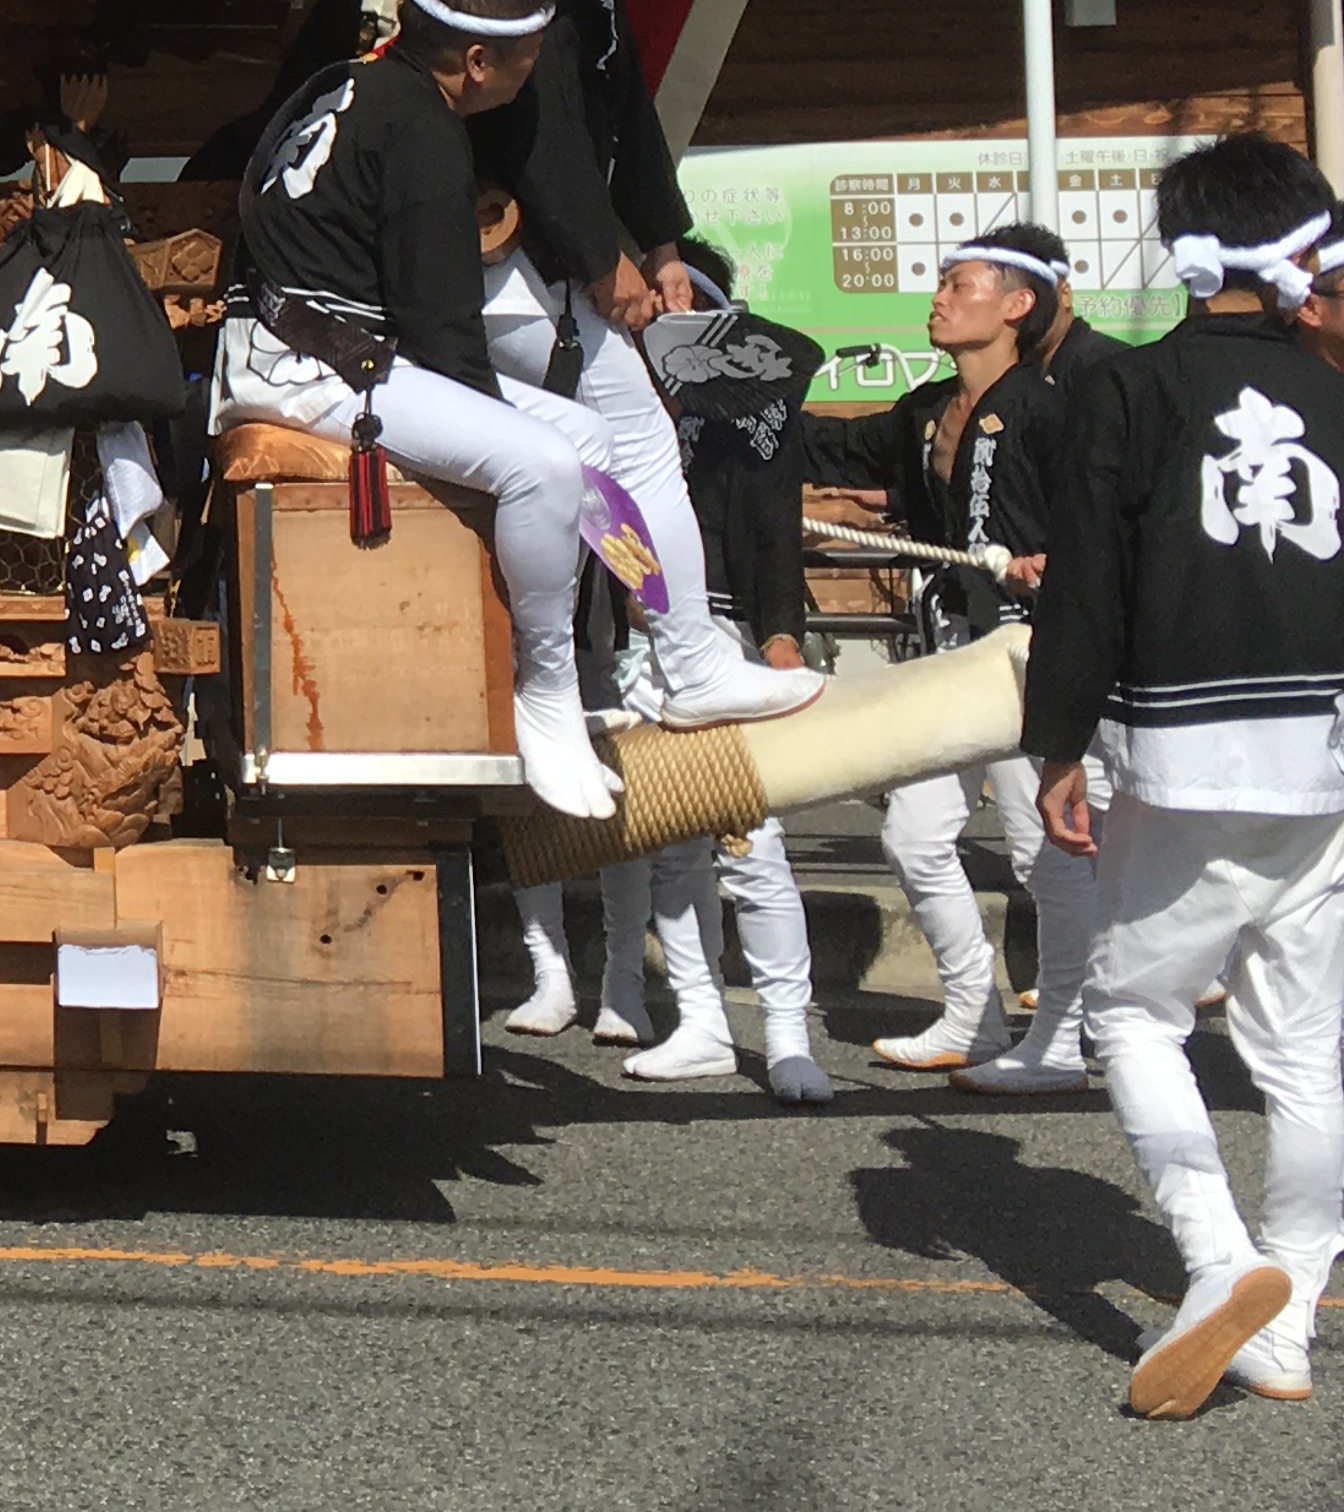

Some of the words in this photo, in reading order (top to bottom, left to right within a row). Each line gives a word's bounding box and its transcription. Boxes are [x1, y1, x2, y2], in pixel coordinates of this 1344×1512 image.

[908, 178, 921, 190] 月
[948, 176, 962, 190] 火
[988, 175, 1002, 189] 水
[1068, 173, 1082, 188] 金
[1110, 173, 1124, 187] 土
[843, 248, 894, 262] 16:00
[1201, 386, 1342, 565] 南
